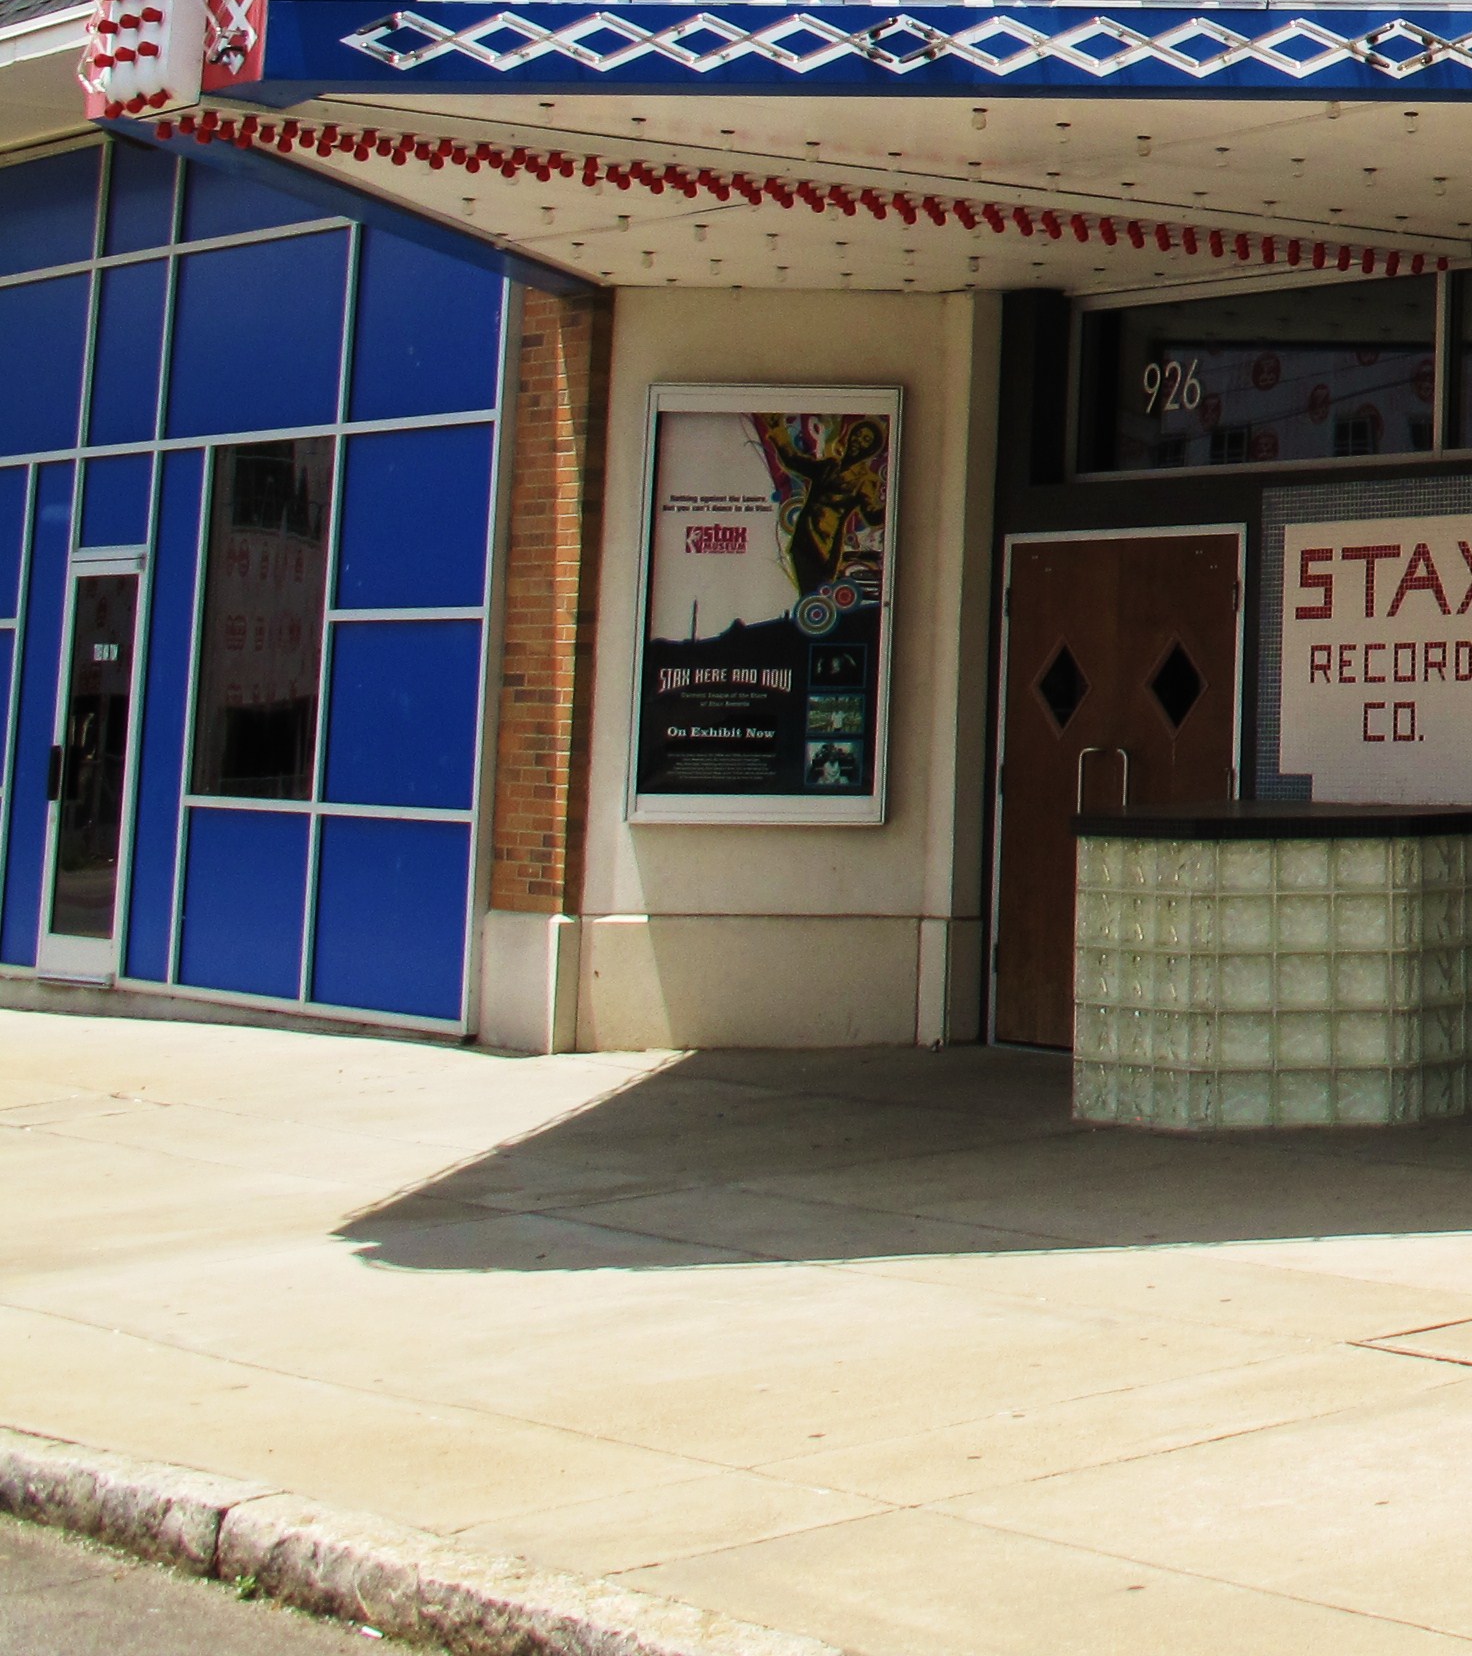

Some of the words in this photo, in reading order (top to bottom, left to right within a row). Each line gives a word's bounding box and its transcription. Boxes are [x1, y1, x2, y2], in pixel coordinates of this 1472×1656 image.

[1143, 358, 1202, 414] 926
[695, 668, 728, 684] HERE
[667, 726, 687, 738] On
[690, 726, 741, 738] Exhibit
[745, 727, 775, 739] Now
[1362, 701, 1425, 743] CO.
